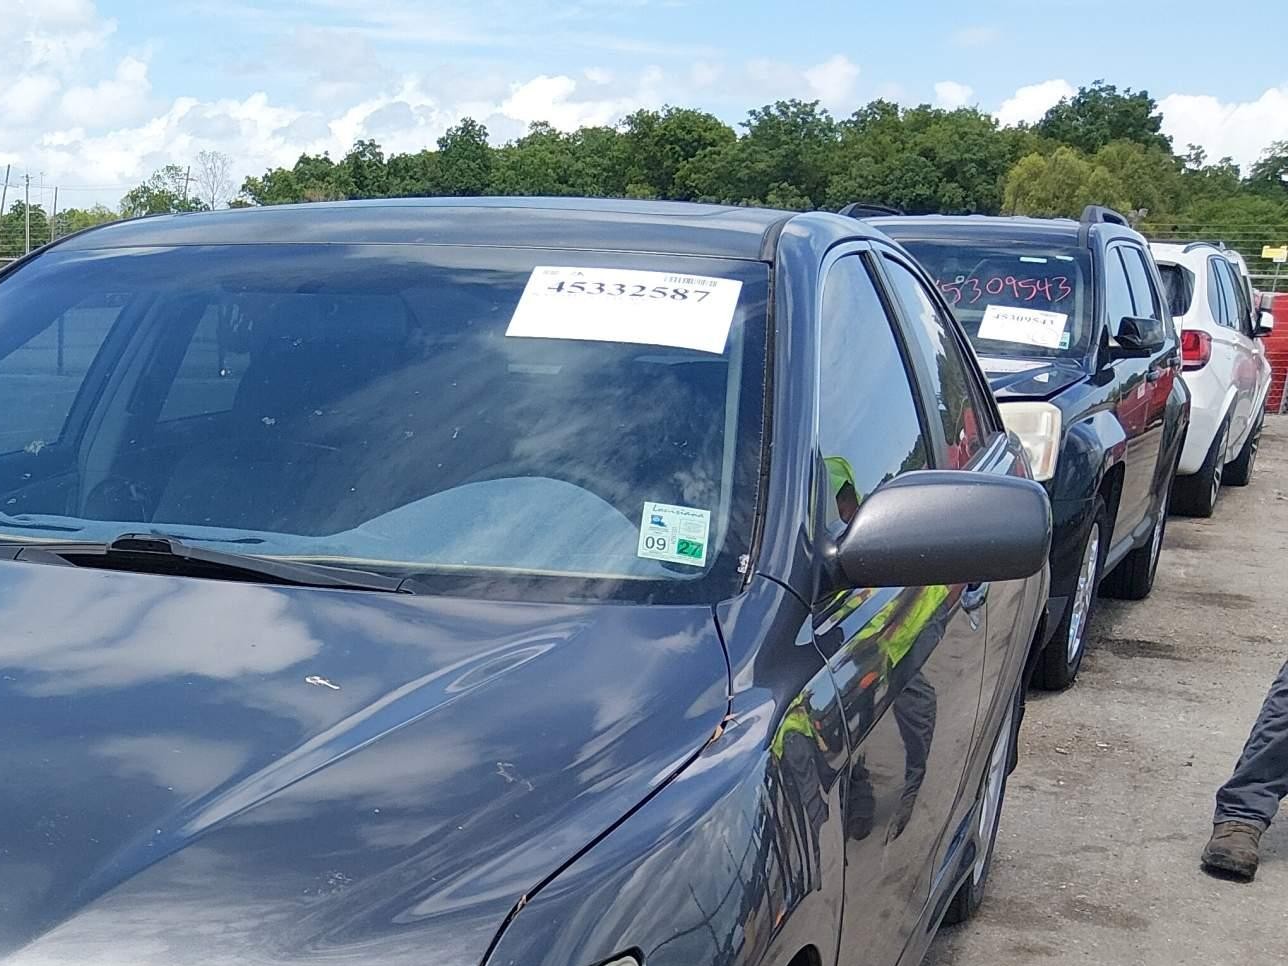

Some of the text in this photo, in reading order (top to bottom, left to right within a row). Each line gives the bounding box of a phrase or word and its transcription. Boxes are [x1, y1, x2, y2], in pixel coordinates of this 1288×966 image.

[547, 280, 711, 302] 45332587
[645, 536, 666, 551] 09
[677, 540, 703, 556] 27
